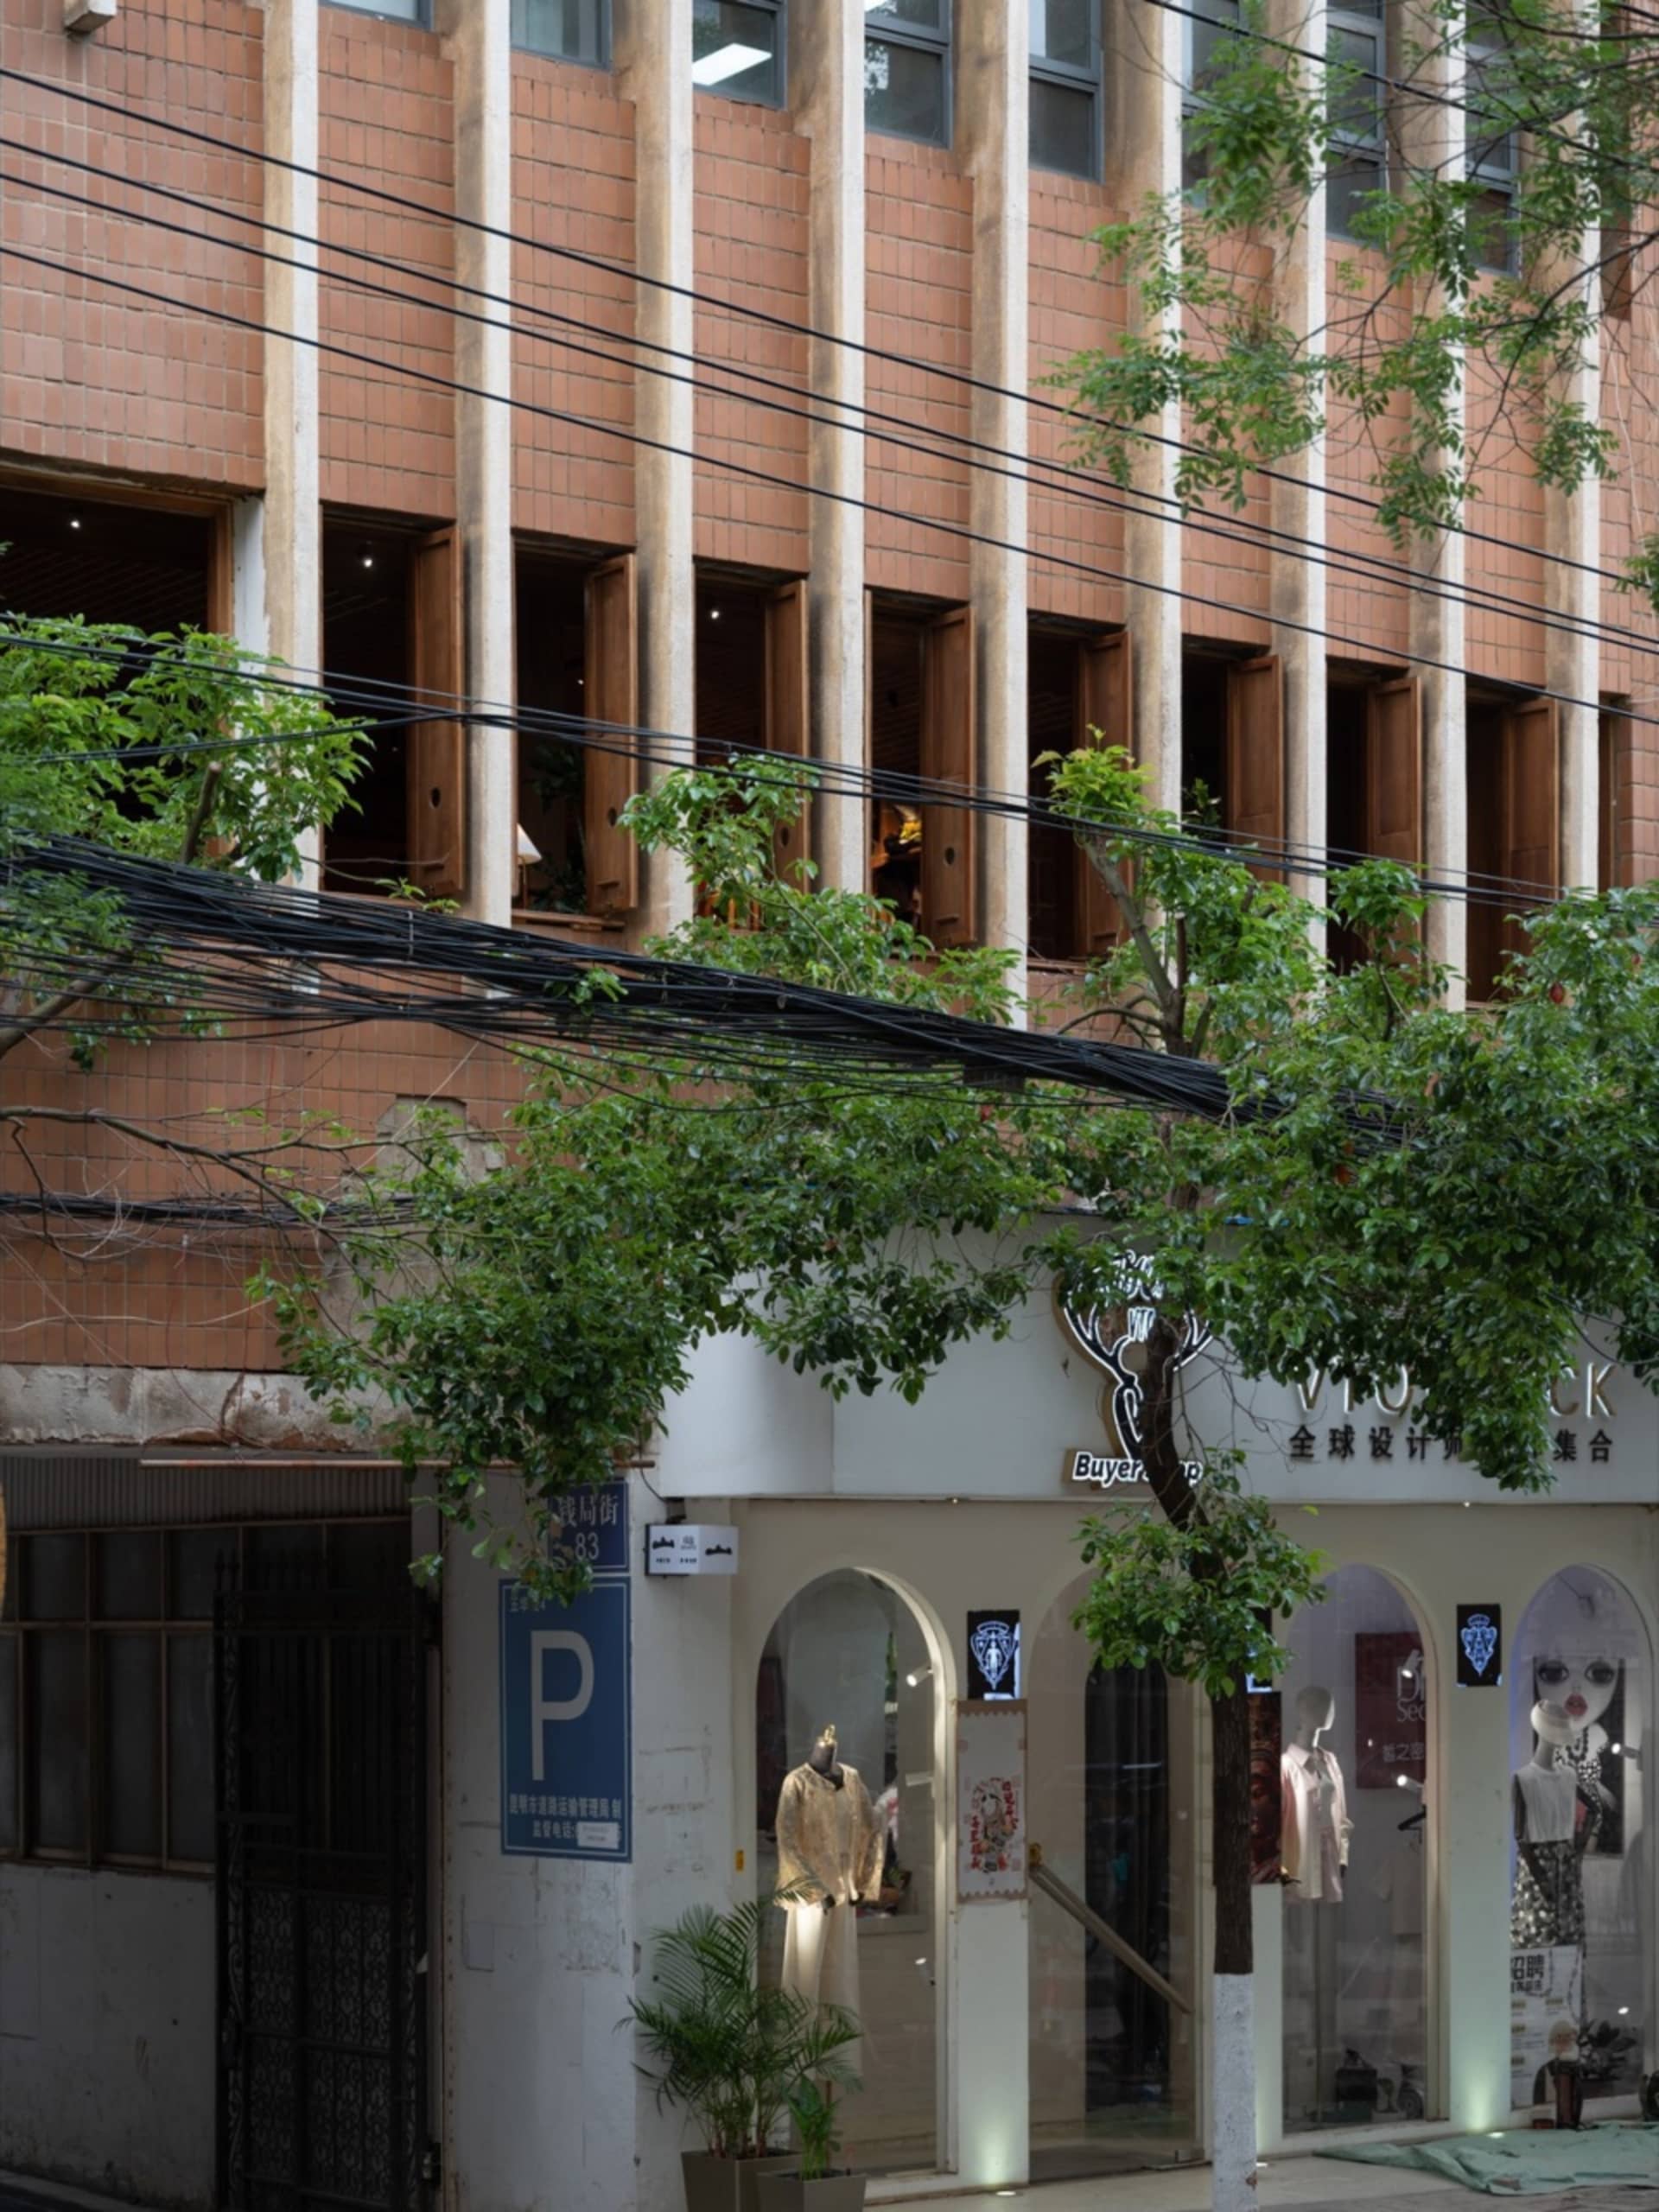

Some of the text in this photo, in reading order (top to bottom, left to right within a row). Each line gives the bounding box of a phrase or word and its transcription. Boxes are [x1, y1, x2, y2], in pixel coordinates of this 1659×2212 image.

[1288, 1424, 1614, 1463] 全球设计师集合
[530, 1630, 595, 1781] P
